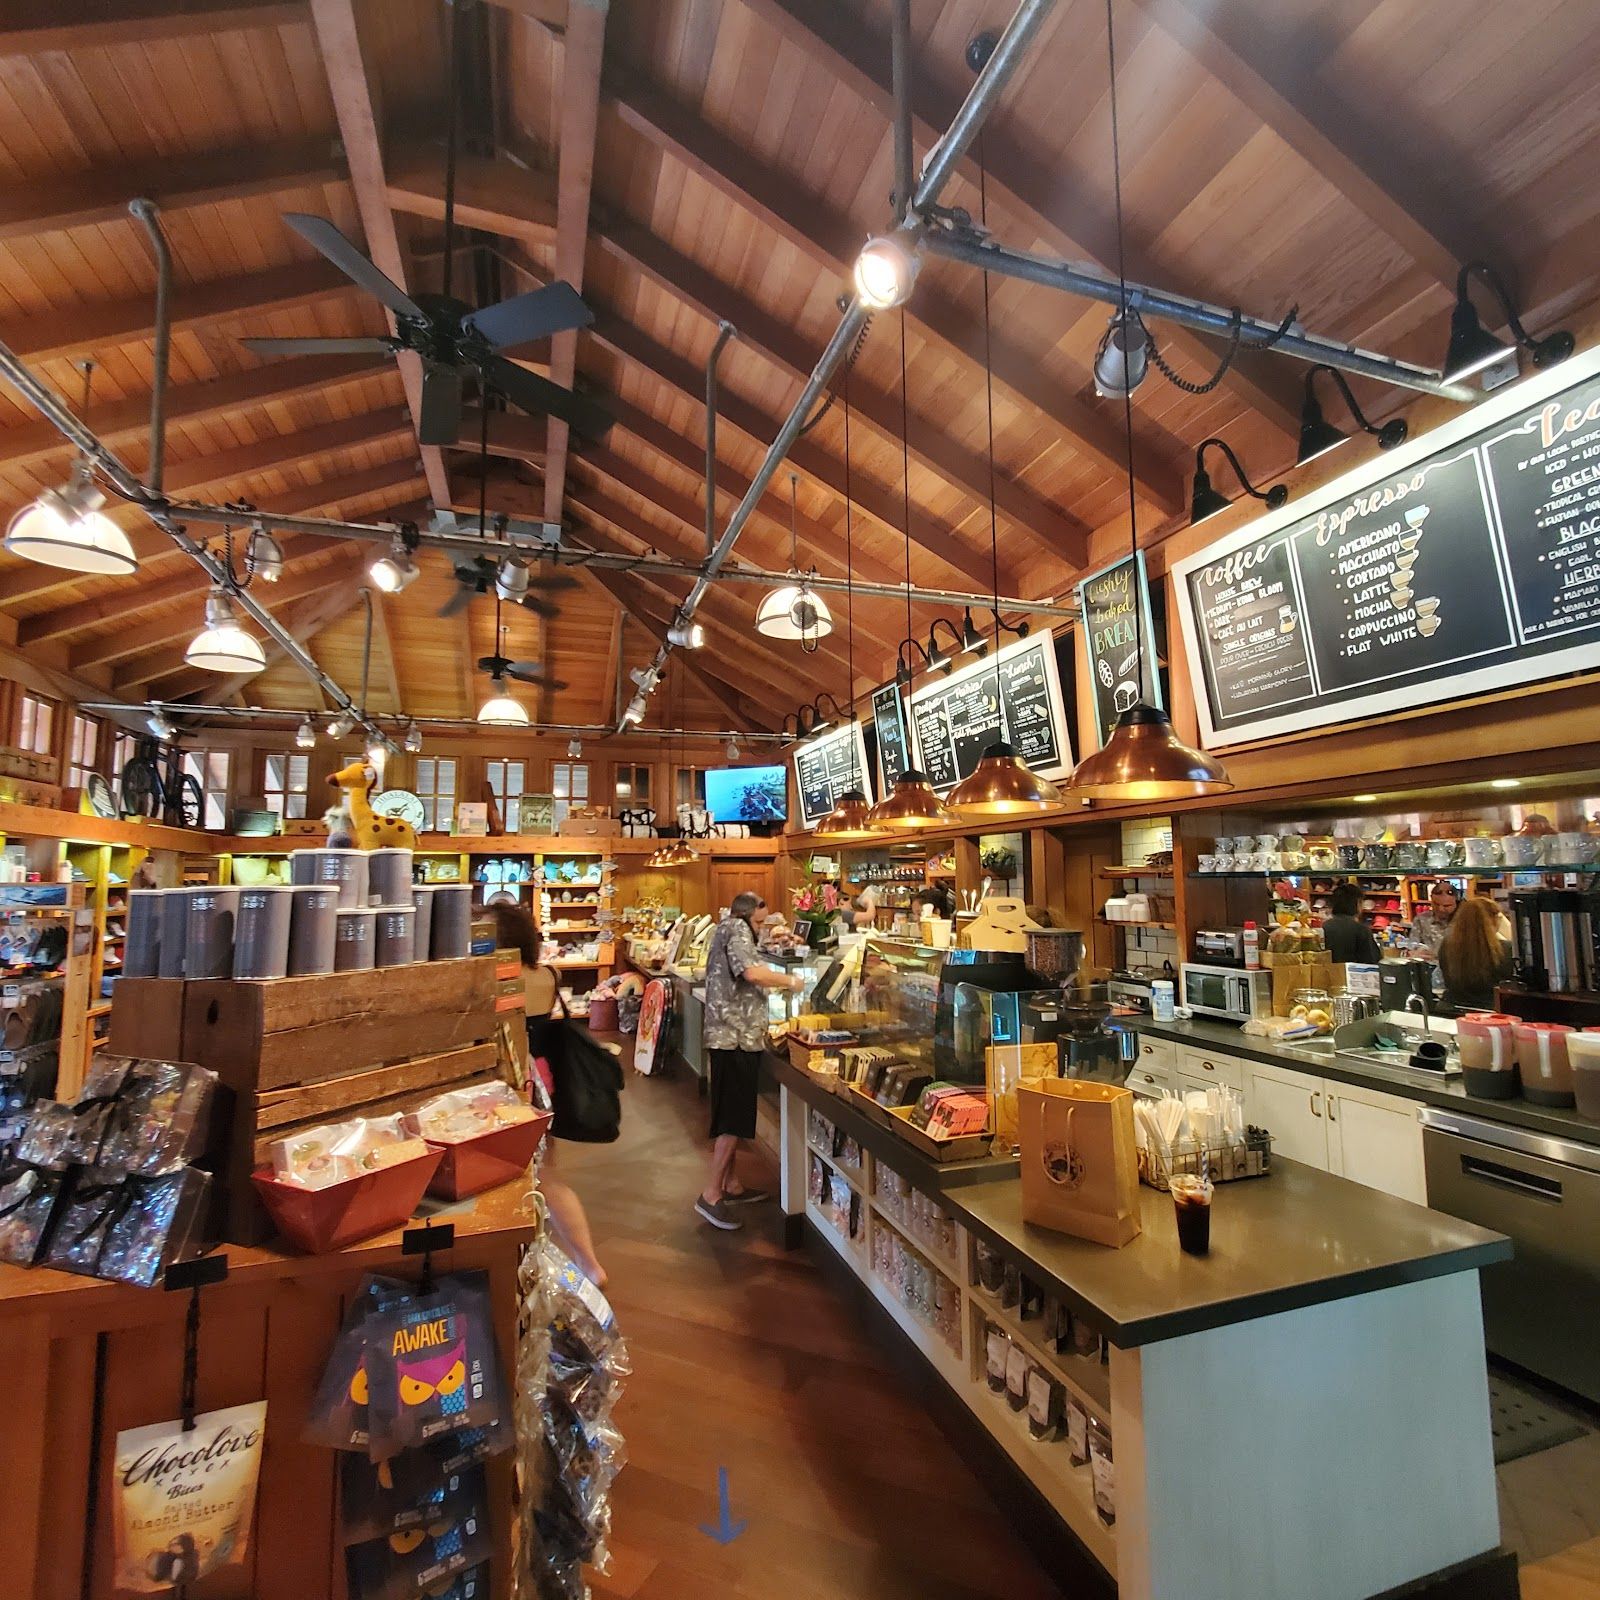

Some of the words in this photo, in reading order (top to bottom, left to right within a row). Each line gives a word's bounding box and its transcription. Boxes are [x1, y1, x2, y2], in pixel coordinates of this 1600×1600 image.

[1316, 473, 1425, 546] Espresso
[1543, 492, 1586, 512] TROPICAL
[1338, 521, 1401, 559] AMERICANO
[1548, 541, 1587, 560] ENGLISH
[1205, 543, 1267, 587] Coffee
[1339, 540, 1400, 576] MACCHIATO
[1568, 553, 1593, 567] EARL
[1241, 575, 1262, 592] BREW
[1347, 561, 1396, 588] CORTADO
[1353, 581, 1391, 604] LATTE
[1564, 584, 1599, 600] MAMAKI
[1095, 594, 1135, 625] baked
[1247, 615, 1263, 629] LAIT
[1355, 599, 1392, 621] MOCHA
[1347, 608, 1417, 640] CAPPUCCINO
[1222, 637, 1246, 653] SINGLE
[1248, 628, 1276, 643] ORIGINS
[1346, 639, 1372, 657] FLAT
[1379, 626, 1417, 648] WHITE
[392, 1318, 449, 1357] AWAKE
[120, 1425, 259, 1487] Chocolove
[166, 1483, 205, 1500] Bites
[185, 1500, 235, 1519] Butter
